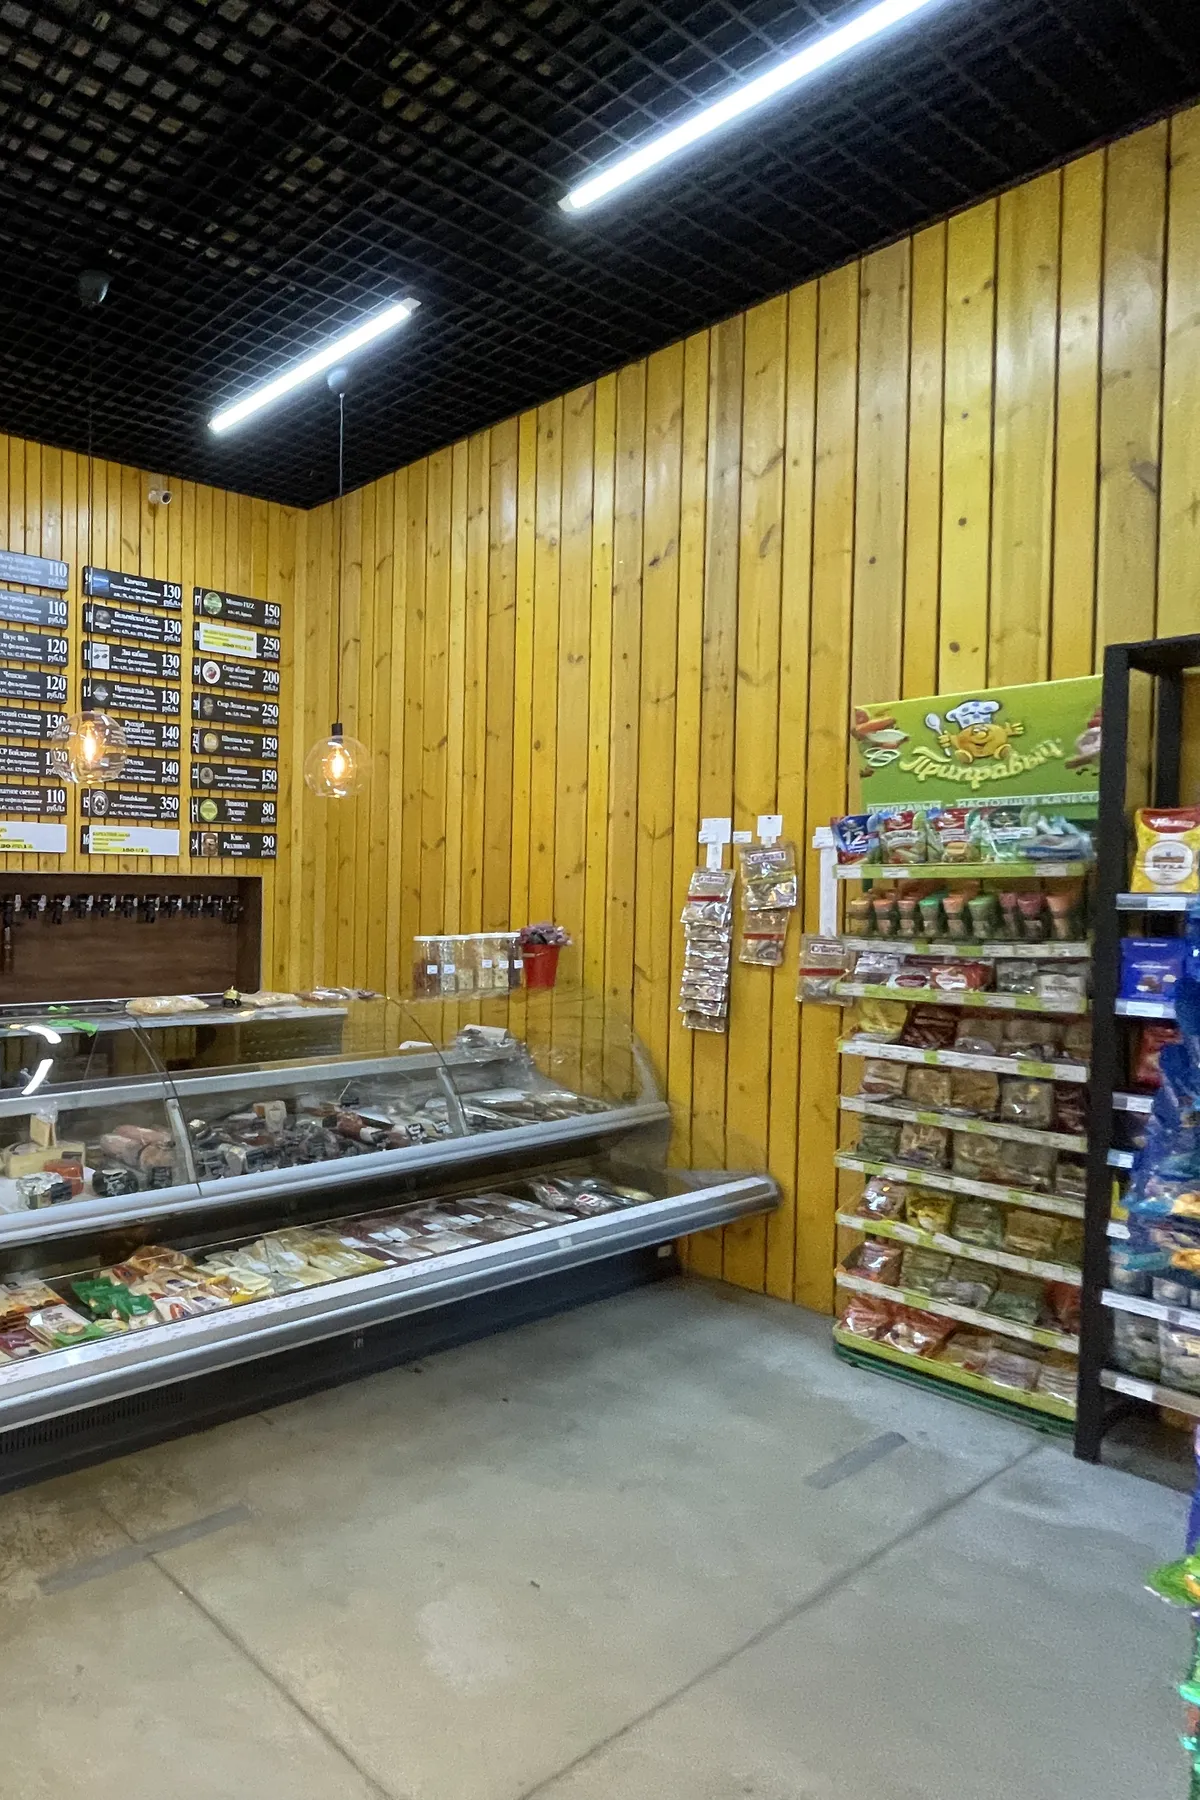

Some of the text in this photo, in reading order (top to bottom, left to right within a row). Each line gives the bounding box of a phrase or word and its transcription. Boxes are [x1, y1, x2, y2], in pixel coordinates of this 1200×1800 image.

[49, 562, 67, 578] 110
[163, 584, 181, 600] 130
[48, 600, 67, 616] 110
[264, 603, 280, 618] 150
[163, 620, 181, 635] 130
[47, 639, 67, 655] 120
[263, 637, 280, 652] 250
[161, 654, 180, 669] 130
[46, 675, 66, 691] 120
[262, 670, 280, 685] 200
[161, 690, 180, 705] 130
[261, 703, 279, 718] 250
[161, 726, 179, 740] 140
[262, 736, 278, 751] 150
[161, 761, 179, 776] 140
[899, 740, 1064, 790] Приправыч
[261, 769, 277, 783] 150
[46, 789, 65, 804] 110
[160, 796, 179, 811] 350
[1041, 793, 1099, 804] КАЧЕСТ
[262, 802, 275, 816] 80
[262, 835, 275, 849] 90
[842, 831, 865, 845] 12
